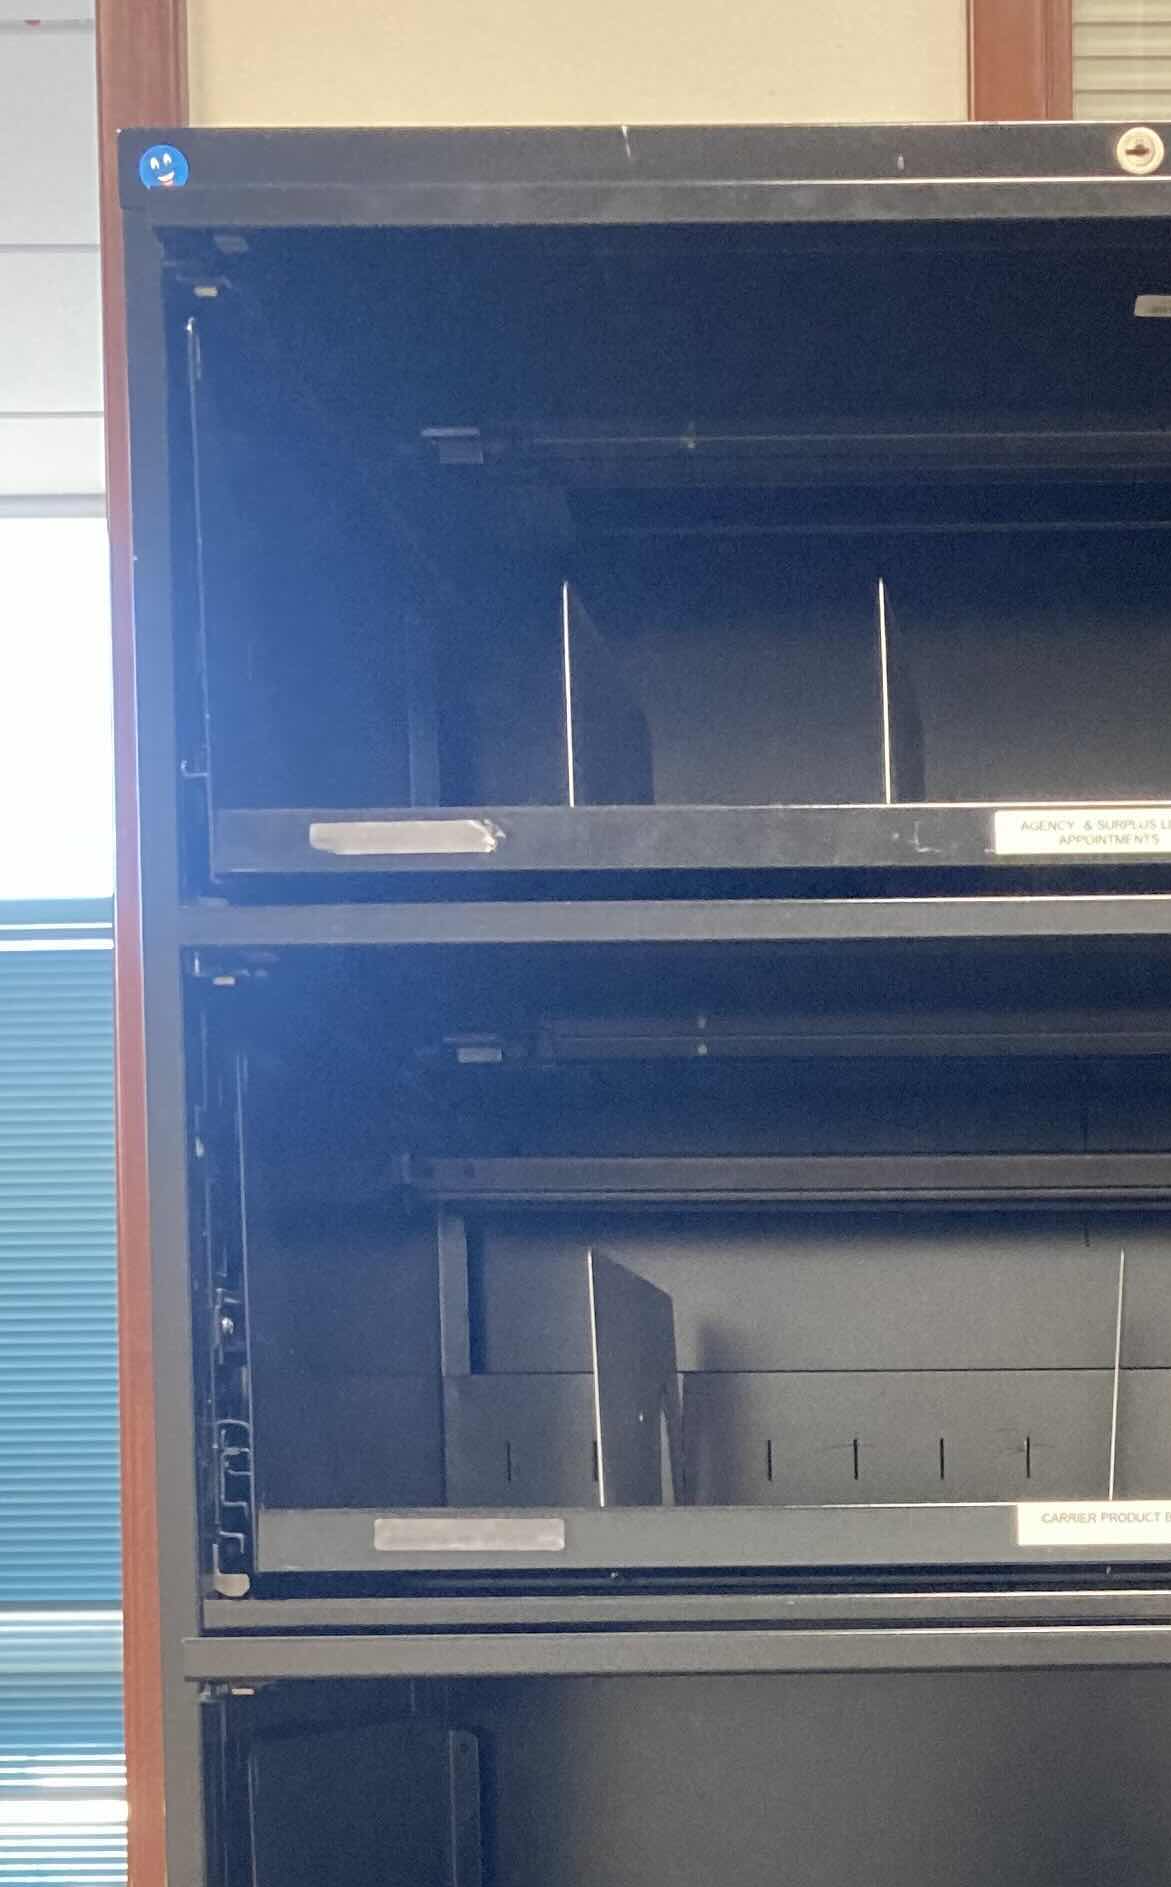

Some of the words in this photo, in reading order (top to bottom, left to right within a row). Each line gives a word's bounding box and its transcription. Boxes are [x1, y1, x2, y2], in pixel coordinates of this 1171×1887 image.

[1020, 820, 1075, 832] AGENCY
[1083, 819, 1095, 831] &
[1097, 818, 1158, 831] SURPLUS
[1058, 833, 1160, 846] APPOINTMENTS
[1040, 1512, 1098, 1525] CARRIER
[1101, 1511, 1162, 1524] PRODUCT
